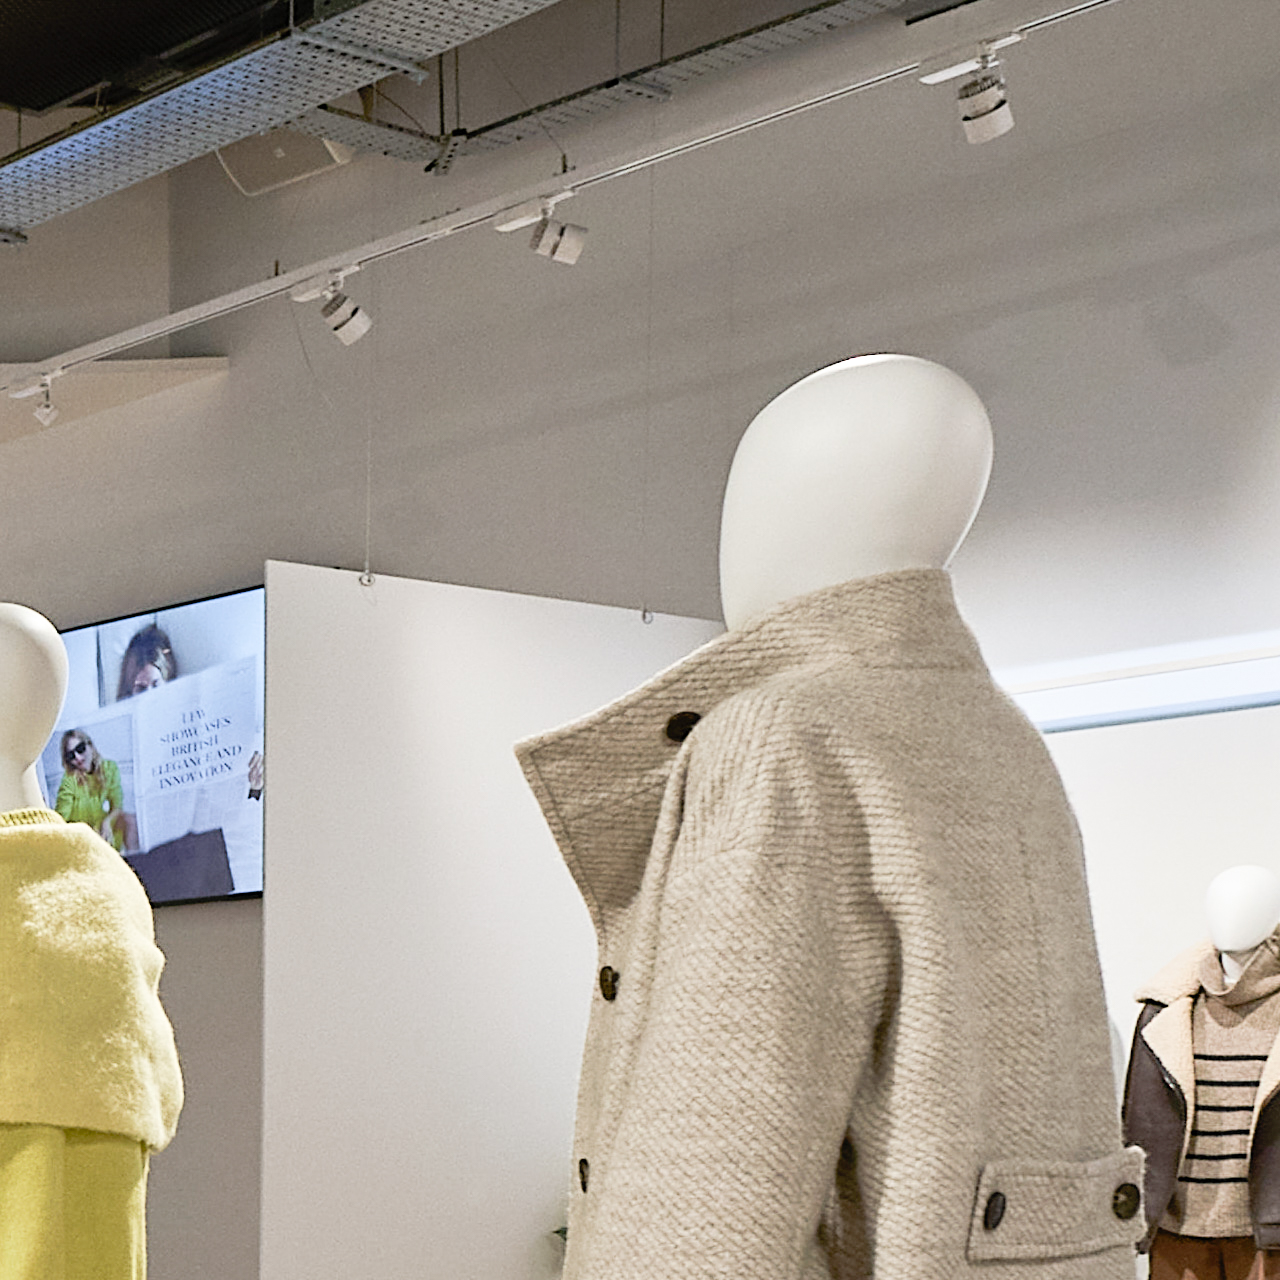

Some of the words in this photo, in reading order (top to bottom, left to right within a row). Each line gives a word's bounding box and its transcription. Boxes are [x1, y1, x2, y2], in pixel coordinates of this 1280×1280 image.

[172, 735, 218, 756] BRITISH
[216, 745, 243, 760] AND
[160, 763, 233, 789] INNOVATION
